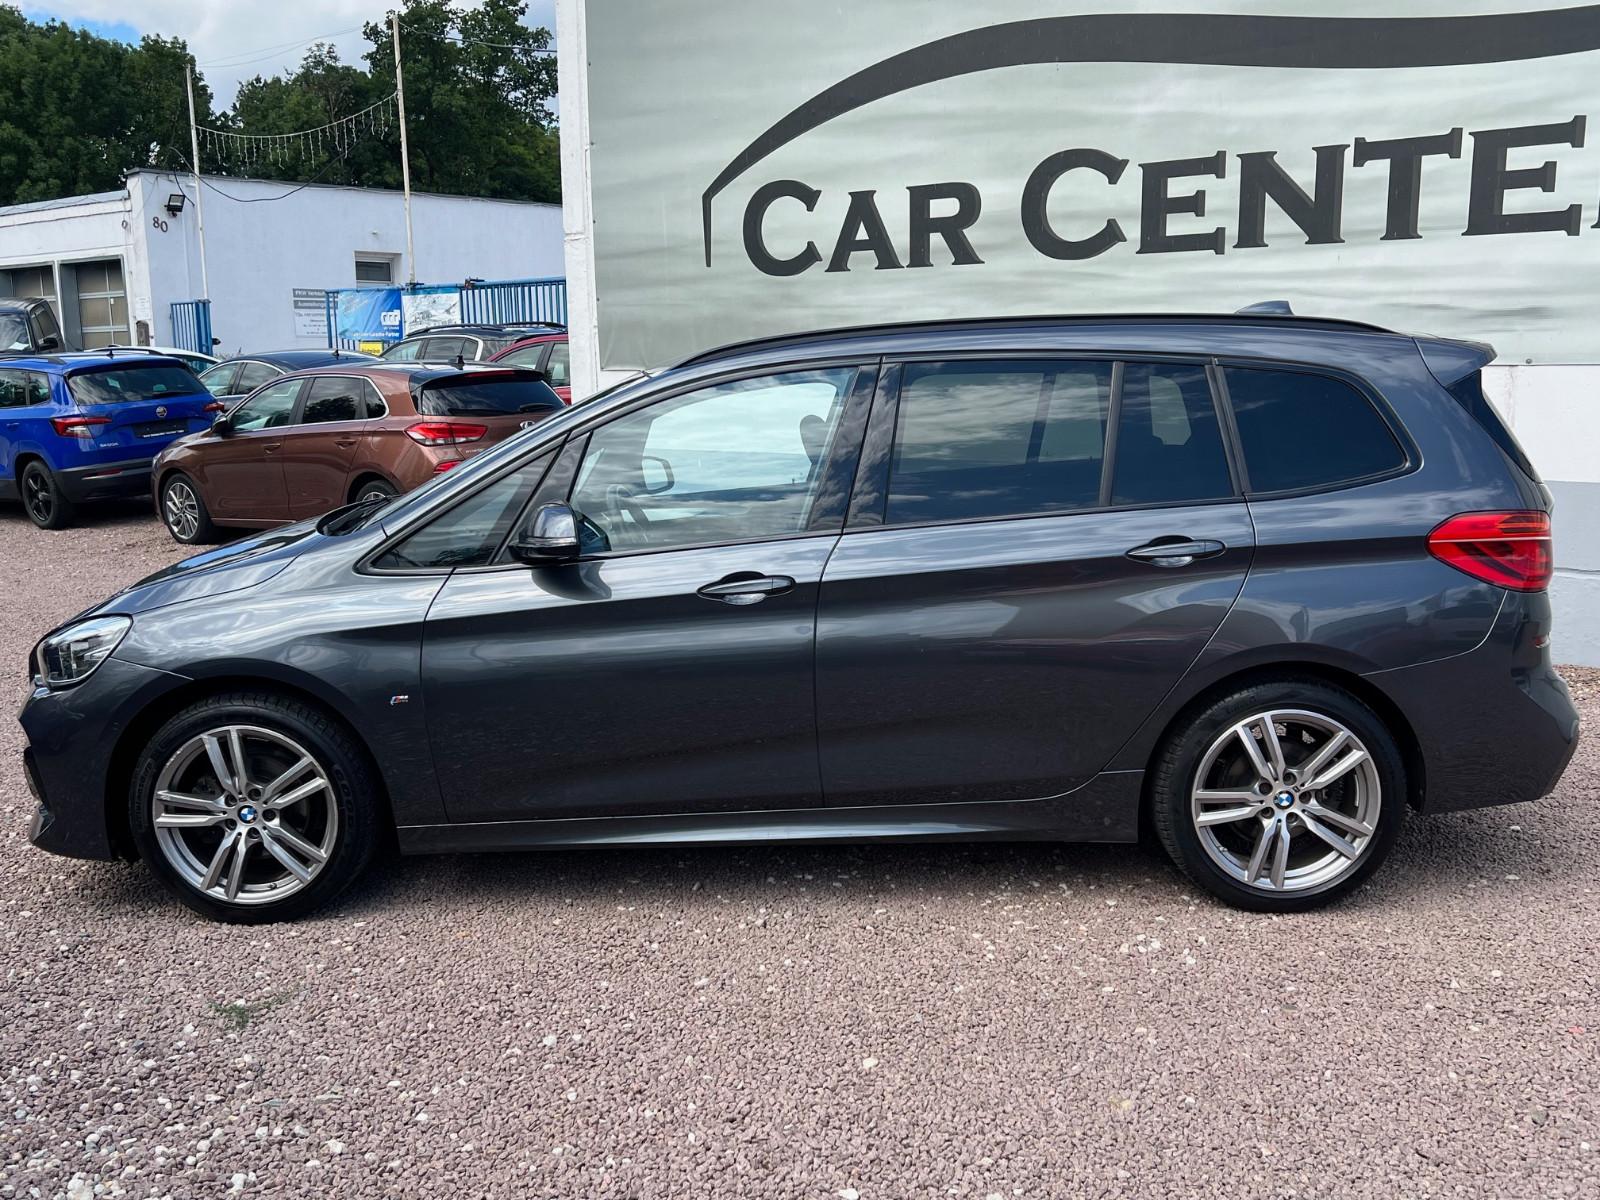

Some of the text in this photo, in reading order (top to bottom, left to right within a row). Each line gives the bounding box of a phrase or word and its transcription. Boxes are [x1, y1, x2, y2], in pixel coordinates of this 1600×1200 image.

[153, 216, 168, 233] 80
[743, 114, 1600, 276] CAR CENTE
